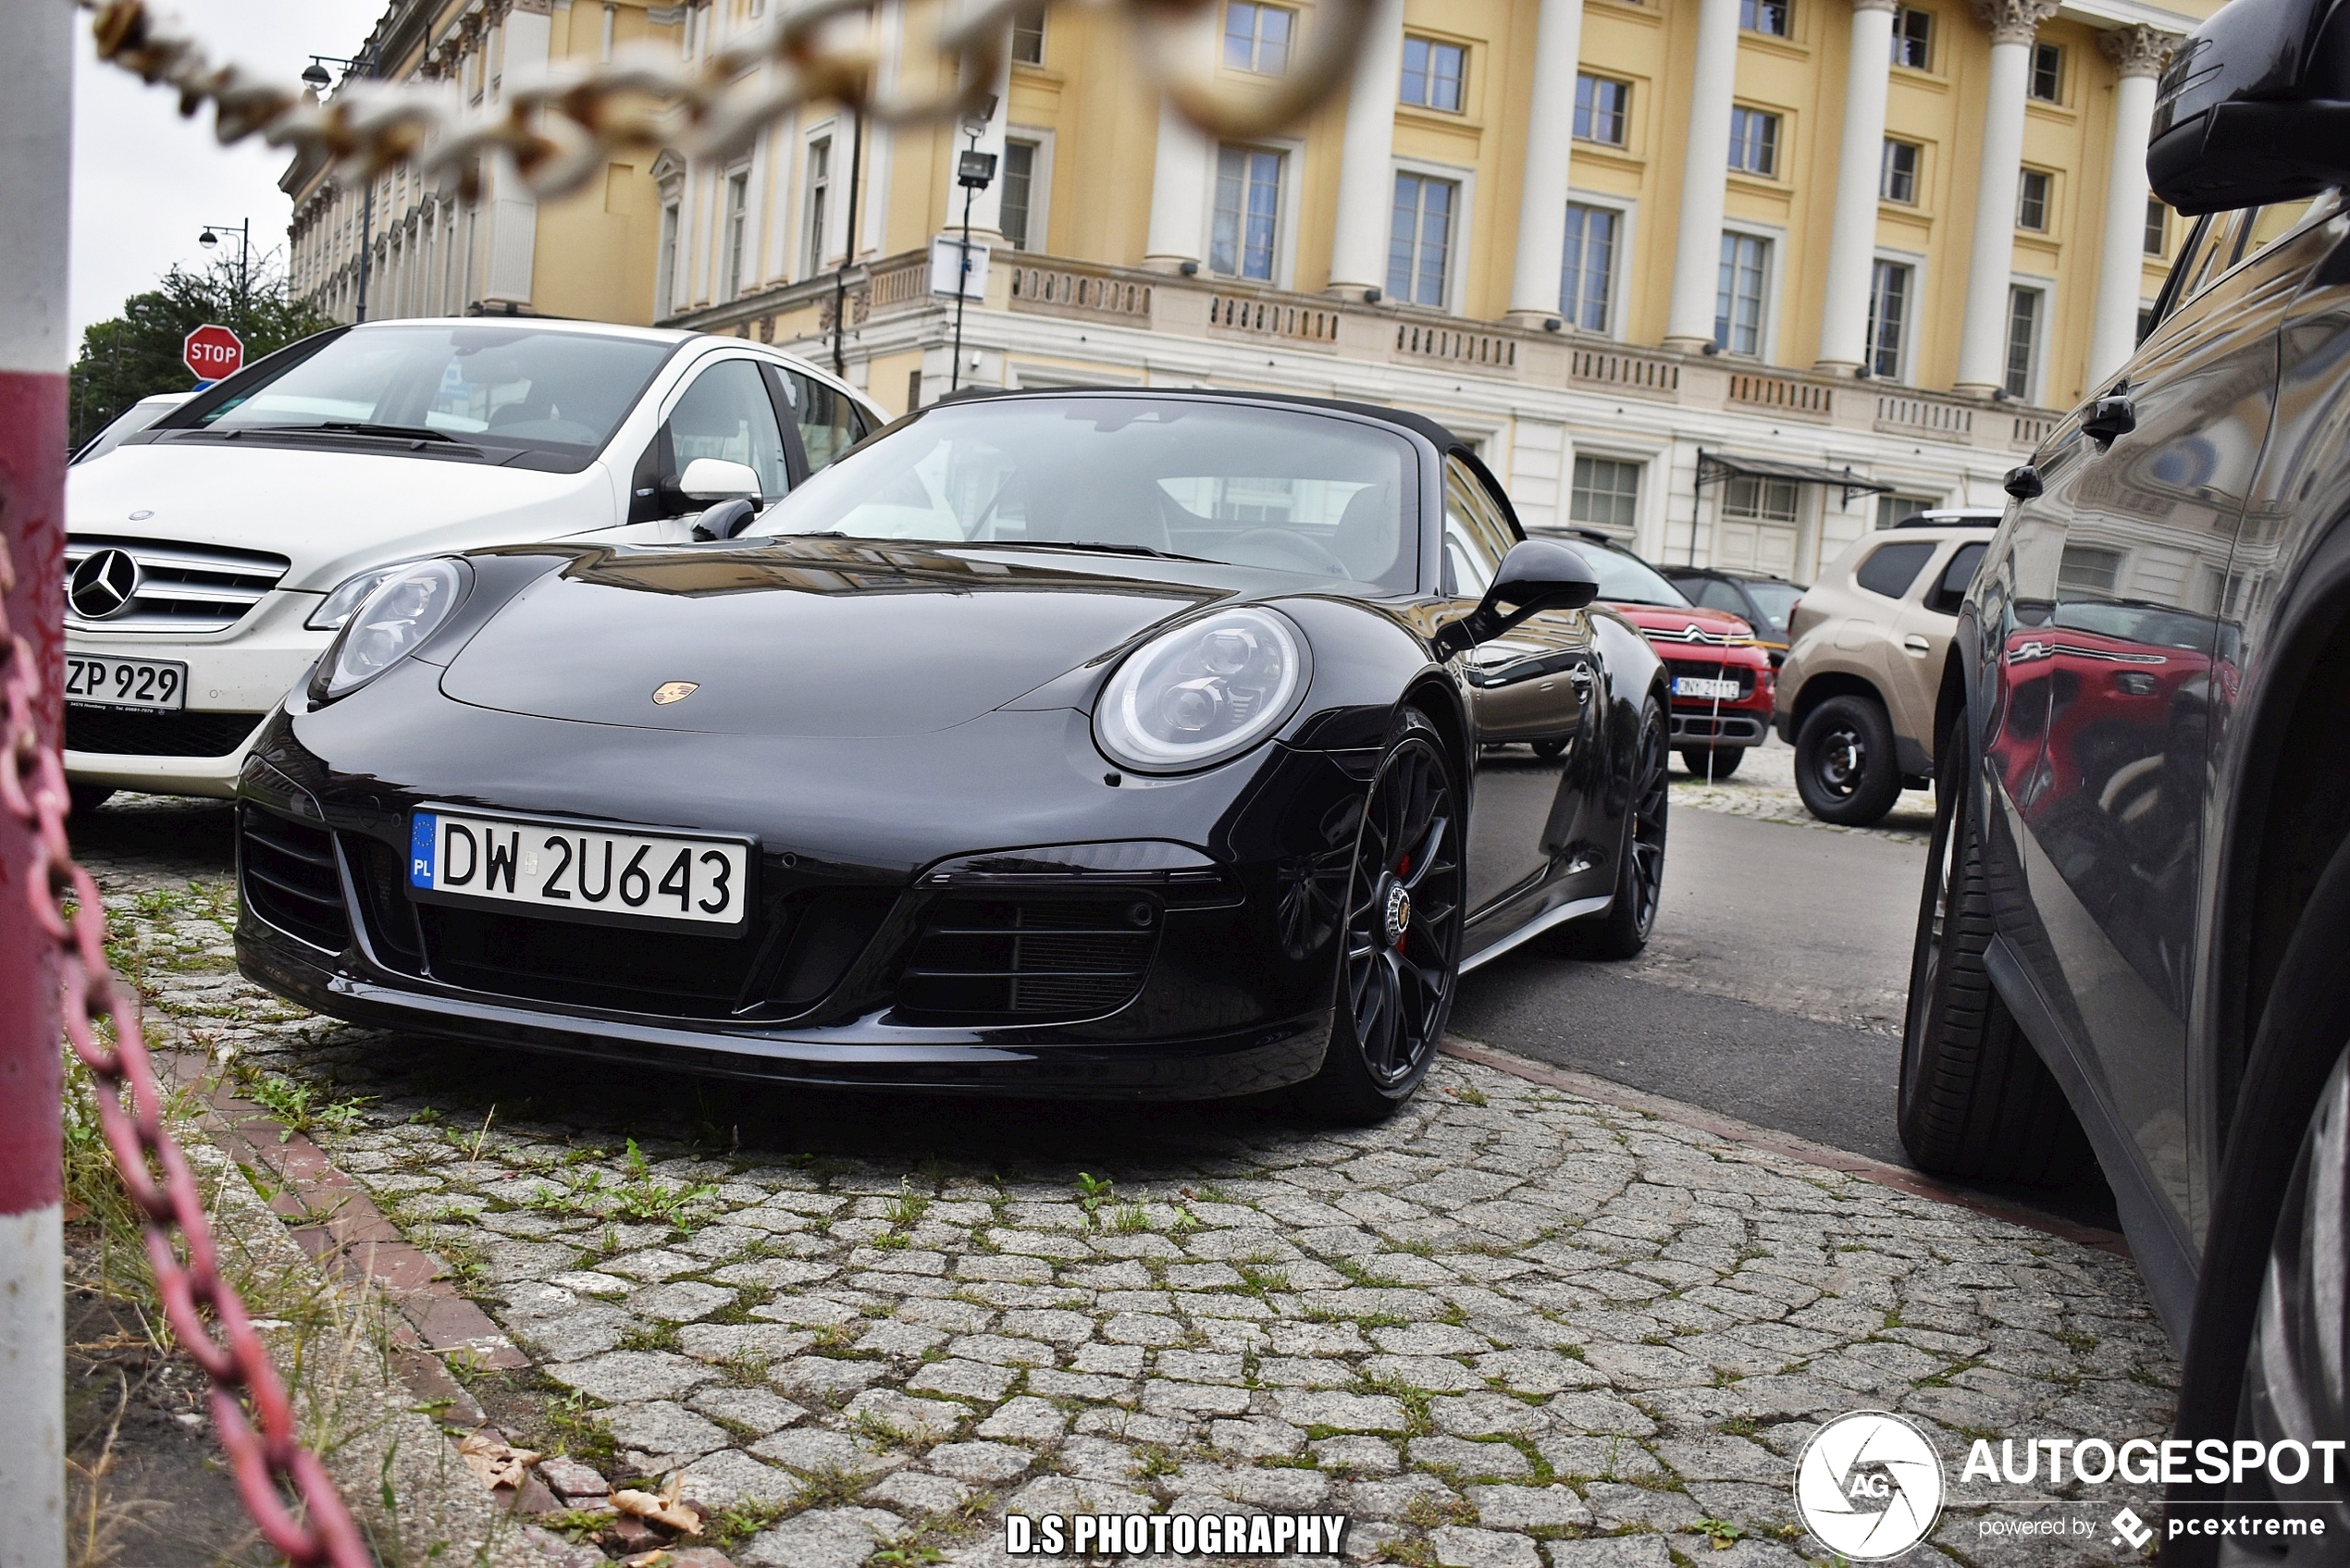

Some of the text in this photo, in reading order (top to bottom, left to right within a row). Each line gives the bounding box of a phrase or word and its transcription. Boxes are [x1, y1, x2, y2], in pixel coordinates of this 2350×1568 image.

[191, 342, 237, 364] STOP
[66, 660, 179, 702] ZP 929
[414, 858, 431, 877] PL
[443, 822, 732, 914] DW 2U643
